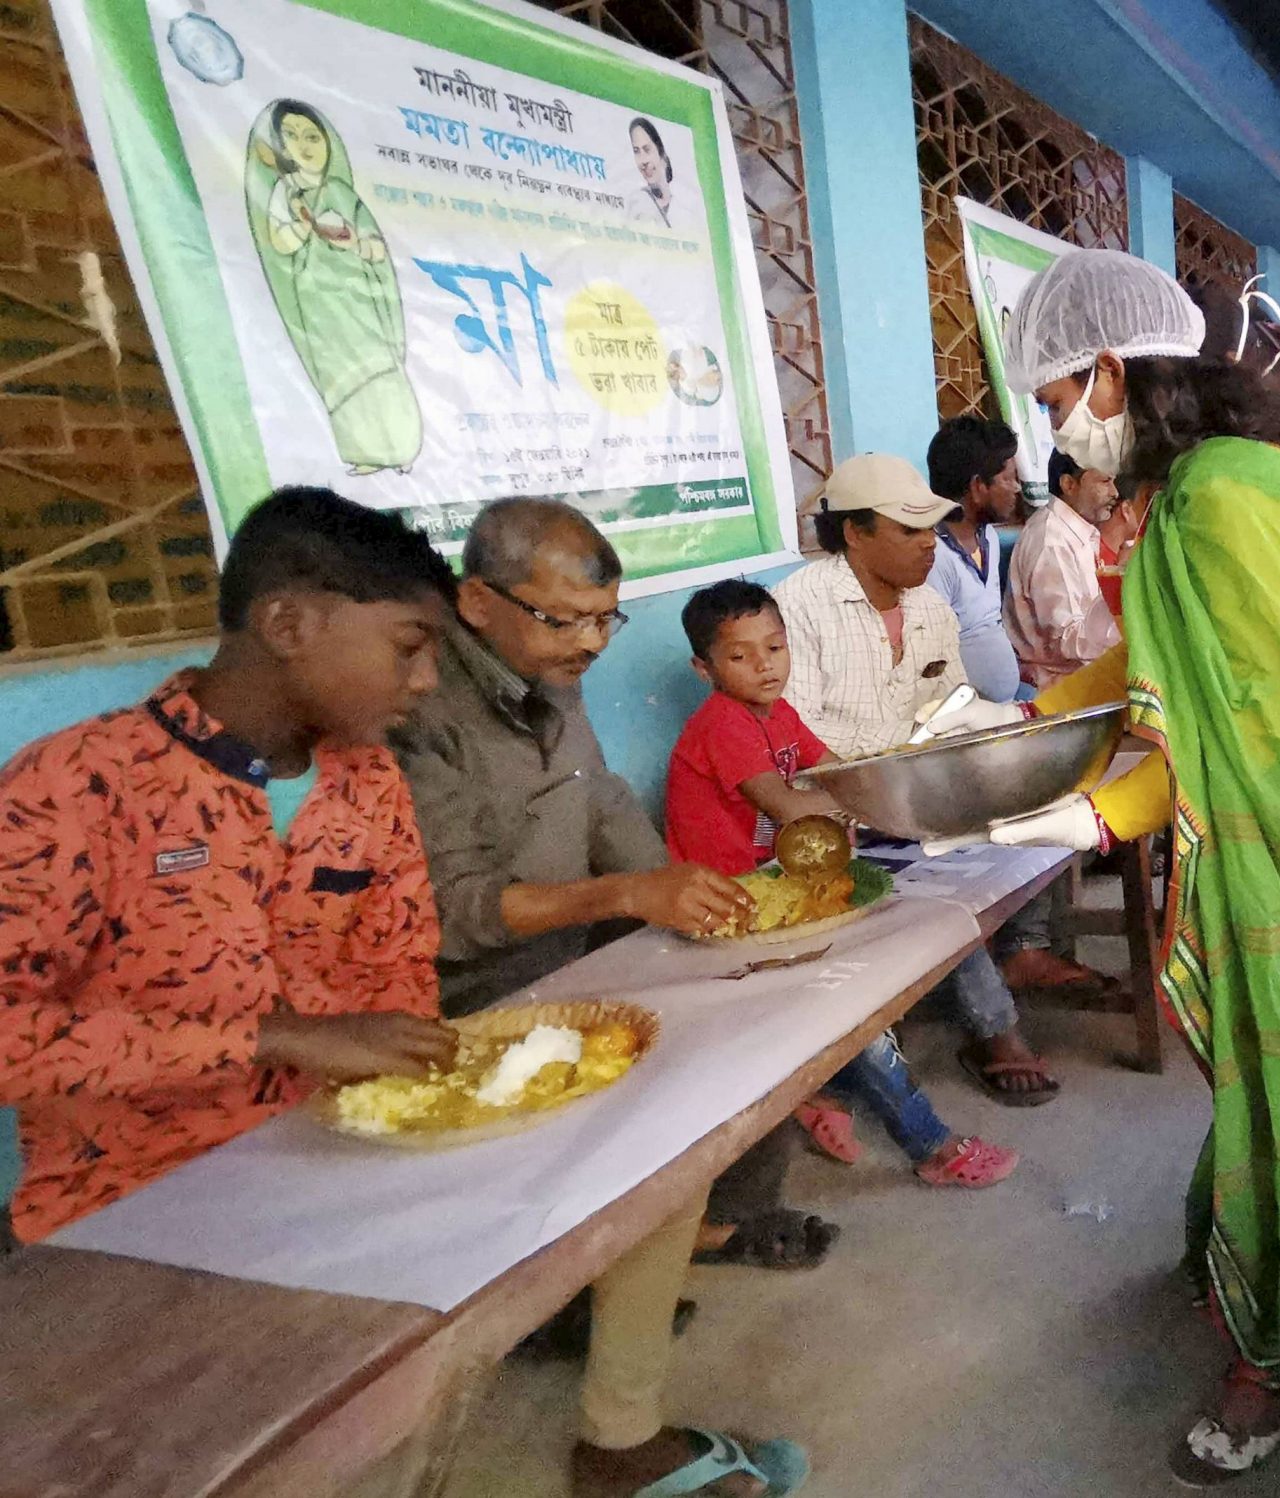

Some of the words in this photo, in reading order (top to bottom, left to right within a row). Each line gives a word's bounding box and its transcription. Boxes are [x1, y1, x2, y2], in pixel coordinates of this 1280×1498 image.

[414, 66, 498, 112] মাননীয়া
[398, 106, 469, 149] মমতা
[480, 127, 607, 180] বন্দ্যোপাধ্যায়
[464, 163, 493, 181] থেকে
[412, 252, 560, 392] মা
[593, 302, 624, 325] মাত্র
[575, 336, 586, 357] ৫
[588, 332, 630, 358] টাকায়
[634, 334, 658, 361] পেট
[588, 371, 617, 393] ভরা
[621, 372, 658, 393] খাবার
[717, 487, 743, 500] সরকার
